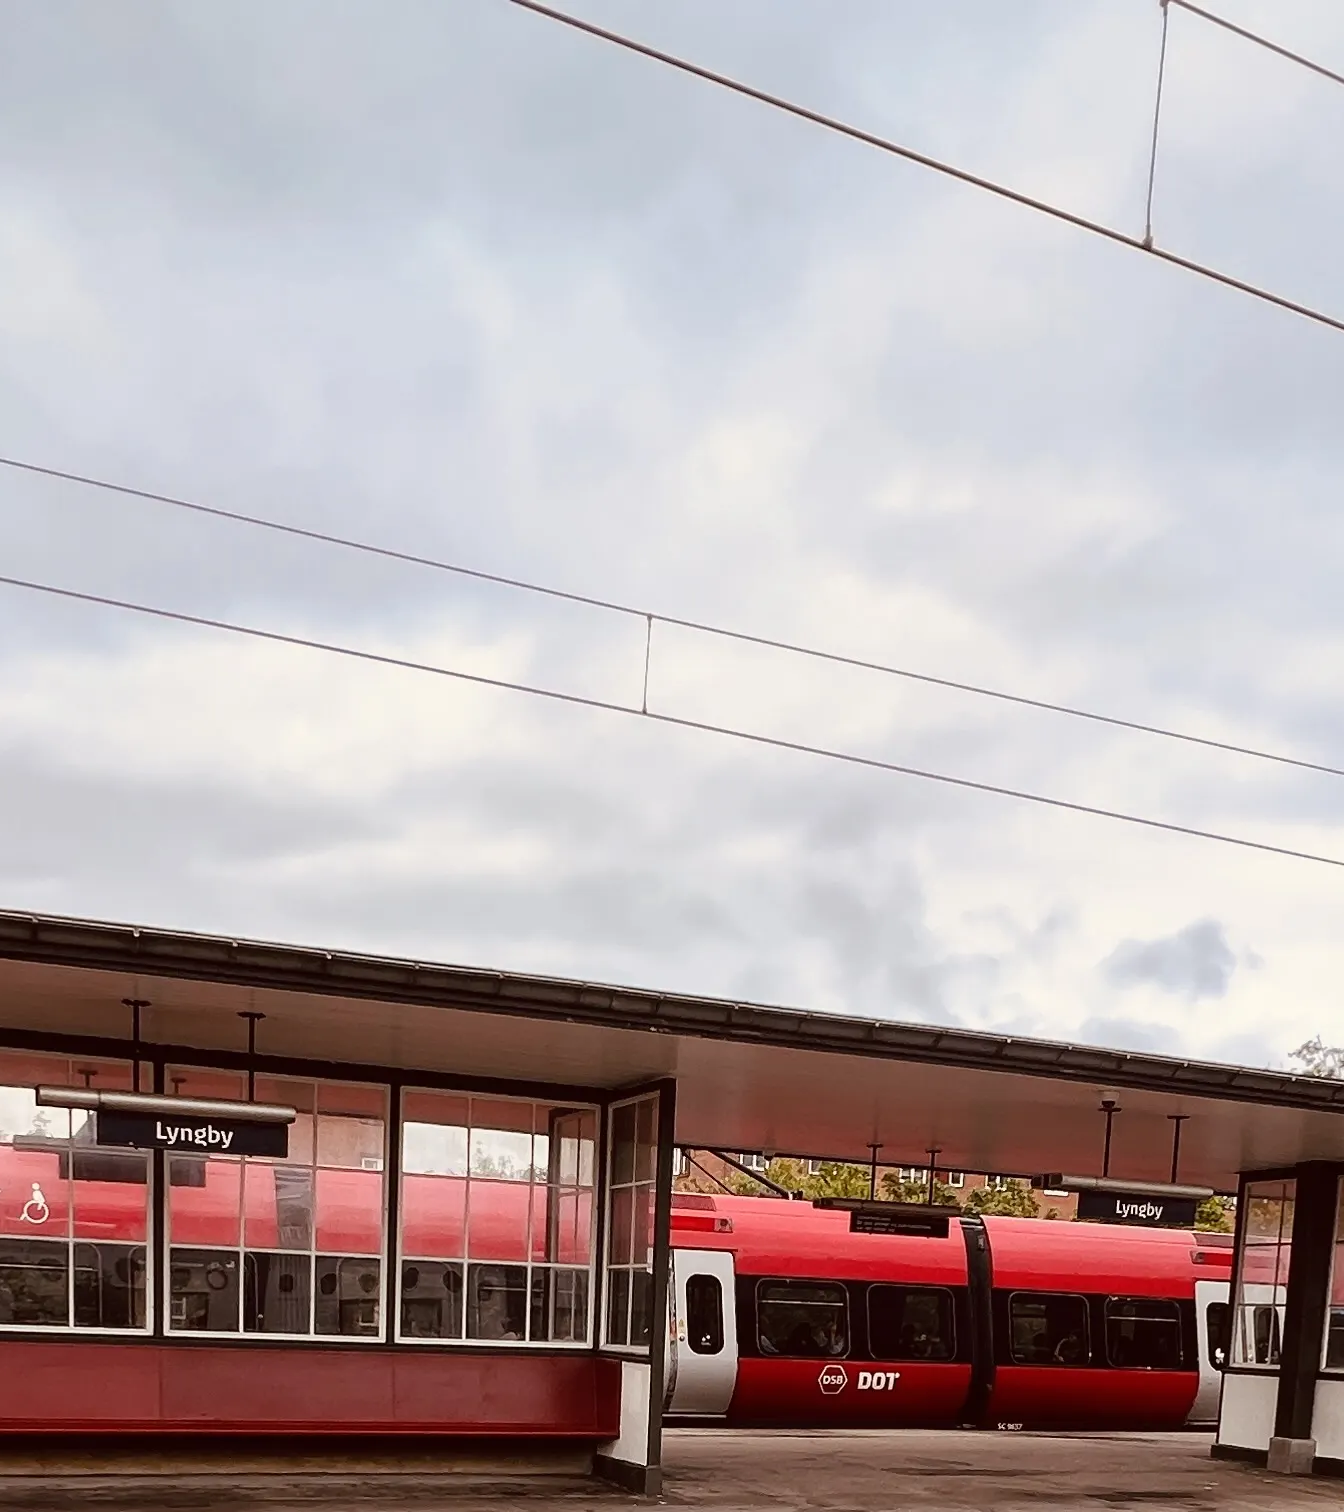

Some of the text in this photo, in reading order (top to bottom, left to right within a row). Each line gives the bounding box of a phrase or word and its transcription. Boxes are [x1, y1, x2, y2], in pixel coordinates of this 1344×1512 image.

[156, 1121, 234, 1149] Lyngby
[1115, 1199, 1164, 1221] Lyngby
[822, 1375, 844, 1385] DSB
